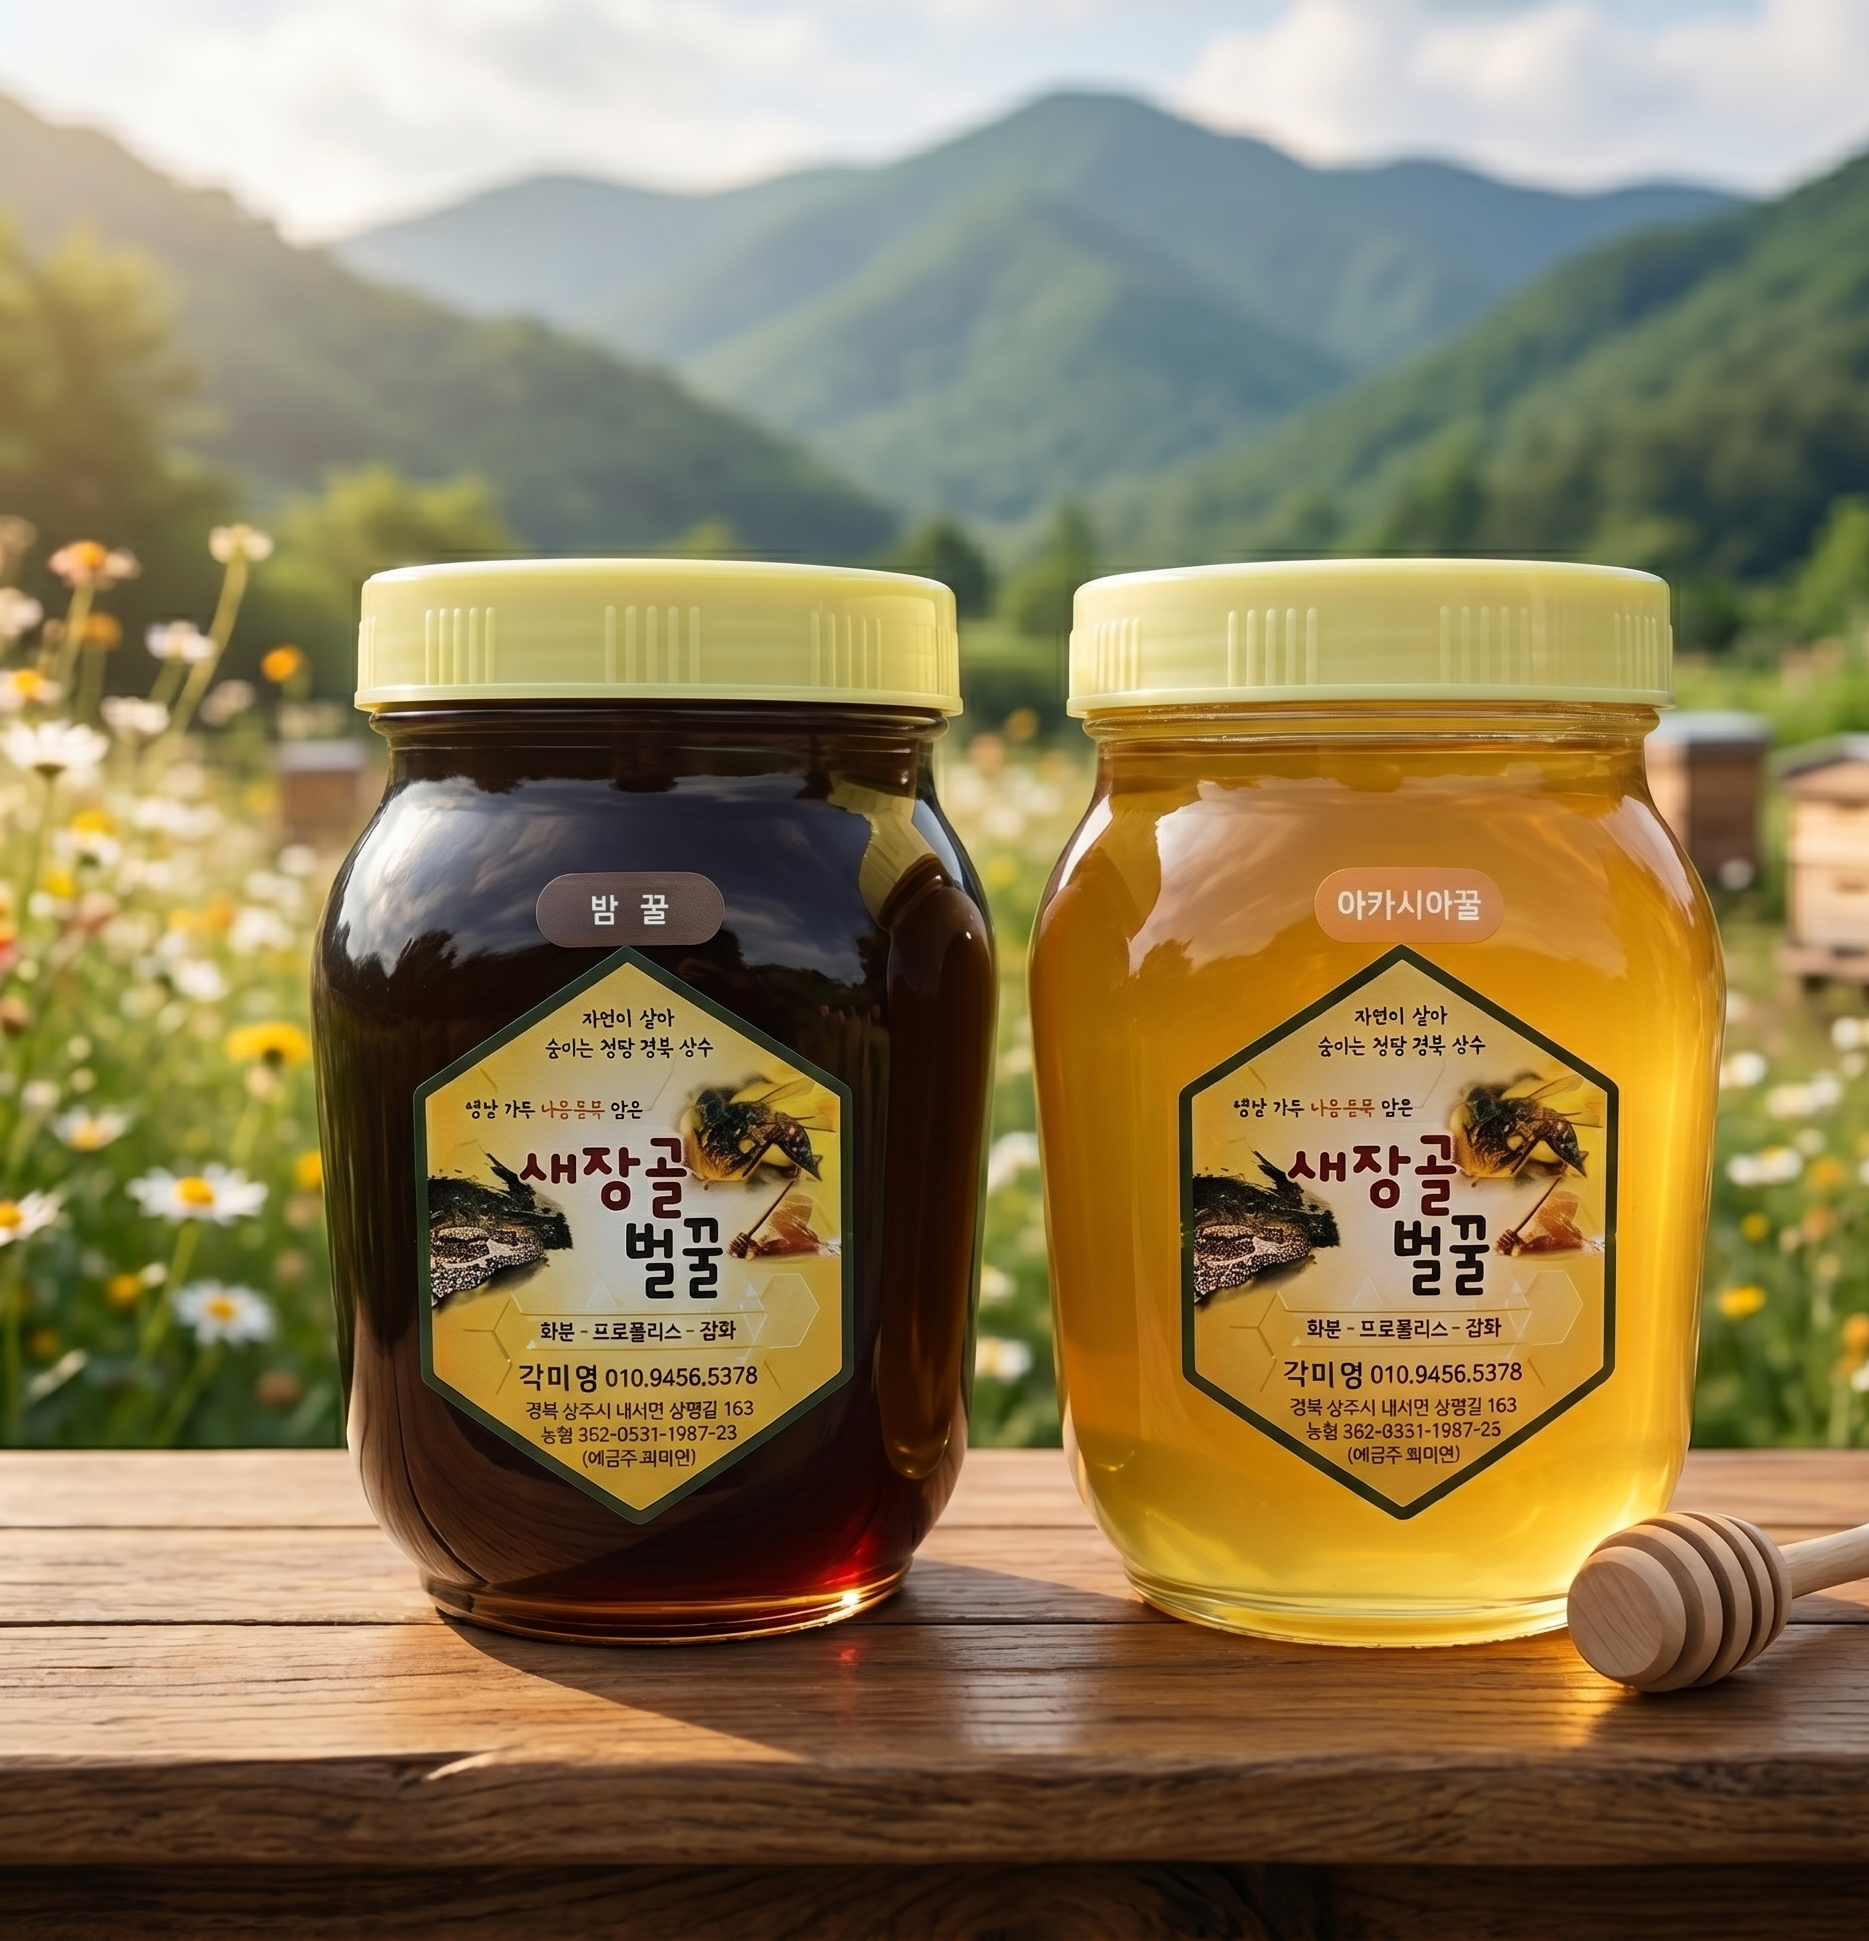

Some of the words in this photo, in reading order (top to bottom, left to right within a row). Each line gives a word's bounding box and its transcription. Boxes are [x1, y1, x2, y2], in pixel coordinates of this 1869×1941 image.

[591, 894, 619, 926] 밤
[640, 894, 669, 925] 꿀
[1337, 889, 1482, 921] 아카시아꿀
[679, 1036, 714, 1058] 상수
[1412, 1034, 1446, 1057] 경북
[1452, 1034, 1487, 1056] 상수
[519, 1137, 688, 1219] 새장골
[1287, 1134, 1458, 1217] 새장골
[626, 1217, 724, 1300] 벌꿀
[1393, 1214, 1491, 1296] 벌꿀
[540, 1321, 575, 1342] 화분
[1306, 1318, 1342, 1340] 화분
[605, 1366, 759, 1388] 010.9456.5378
[1370, 1362, 1523, 1385] 010.9456.5378
[563, 1402, 611, 1421] 상주시
[724, 1400, 754, 1417] 163
[1326, 1398, 1376, 1418] 상주시
[1487, 1396, 1518, 1413] 163
[578, 1424, 738, 1443] 352-0531-1987-23
